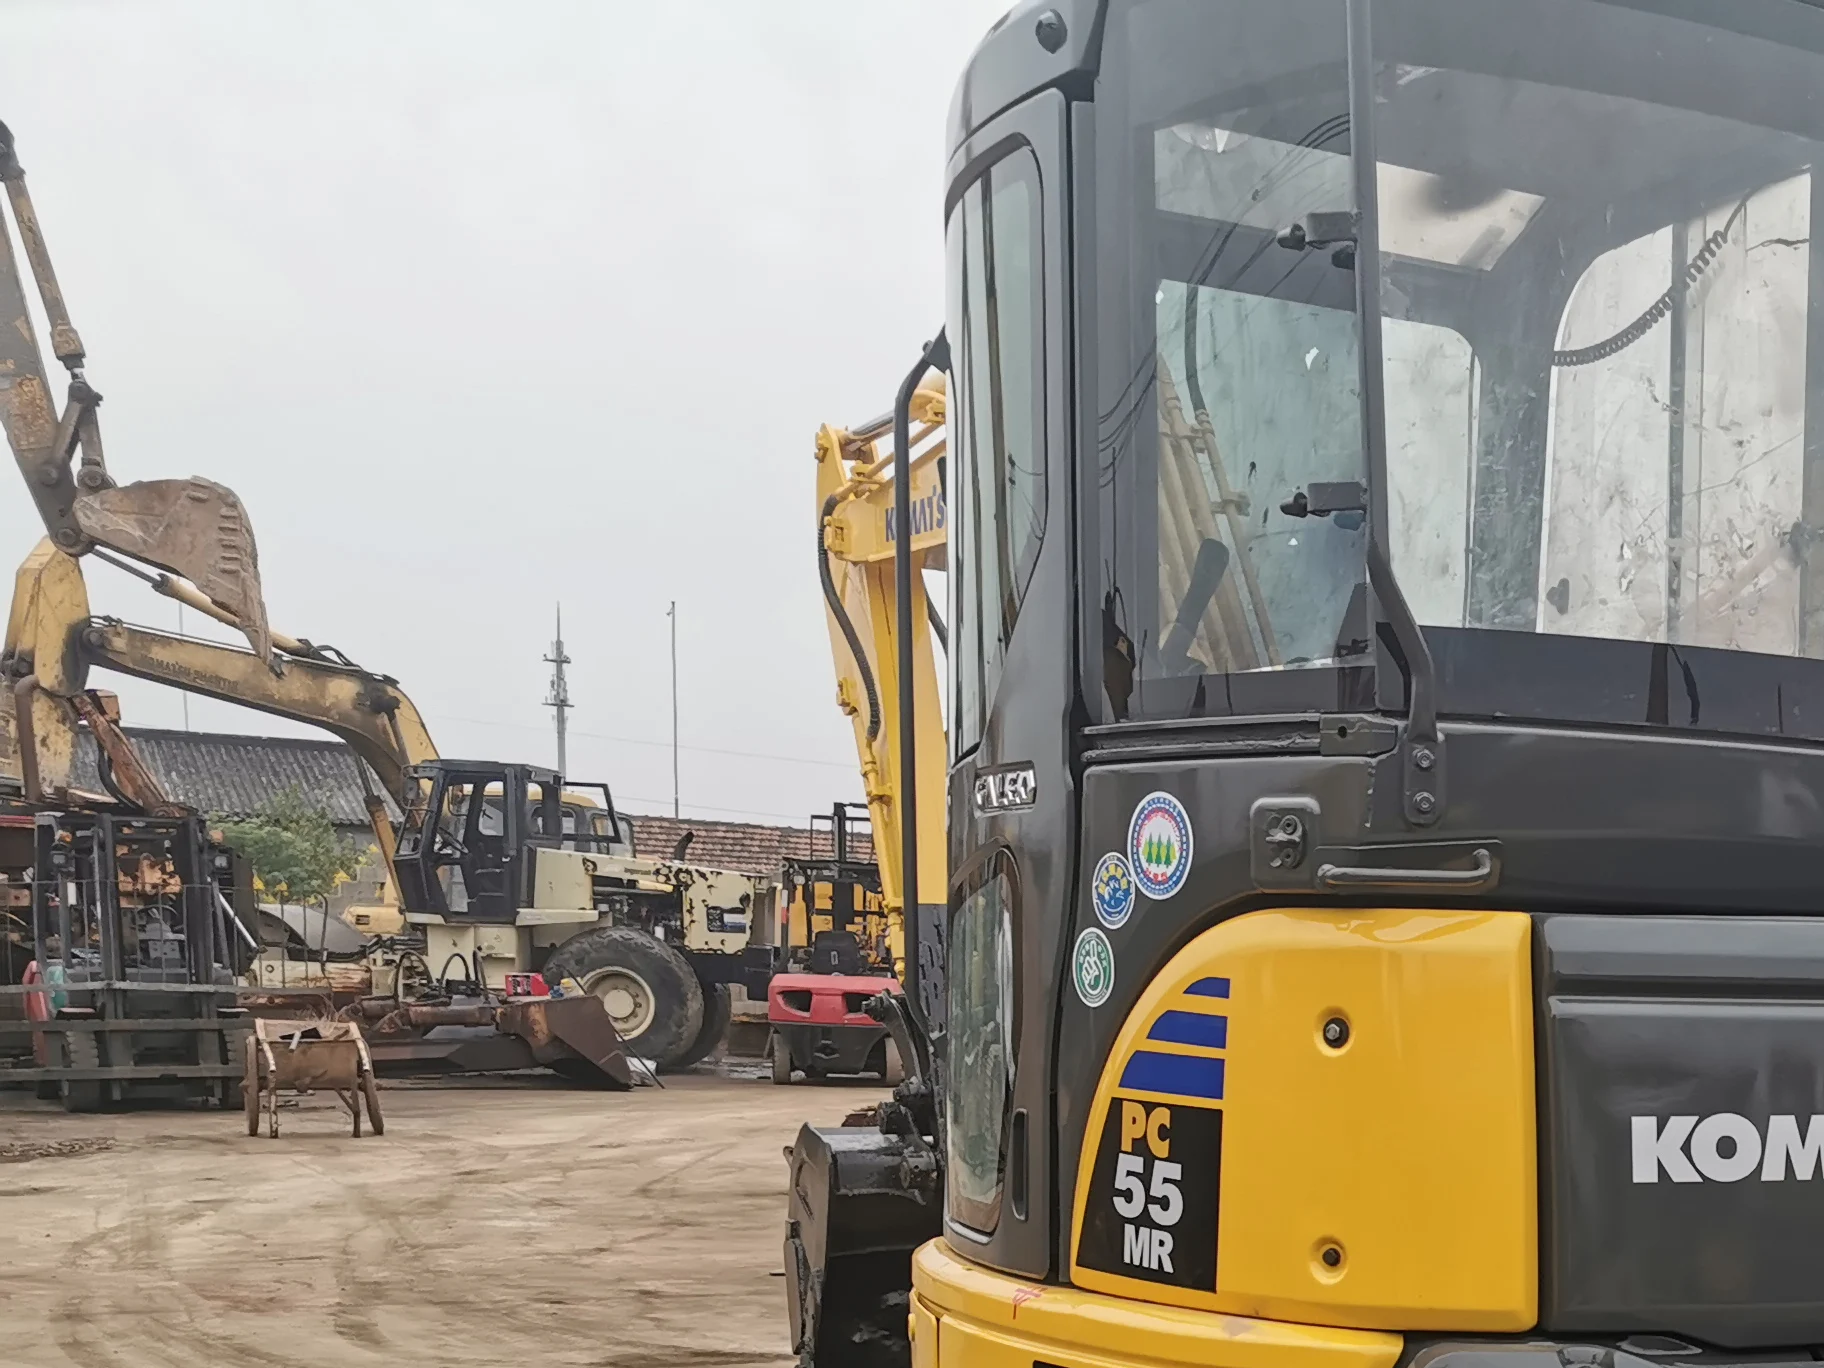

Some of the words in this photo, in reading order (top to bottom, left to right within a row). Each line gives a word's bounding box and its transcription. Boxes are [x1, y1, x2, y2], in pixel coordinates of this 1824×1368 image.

[1120, 1100, 1171, 1159] PC
[1112, 1152, 1184, 1227] 55
[1123, 1223, 1175, 1274] MR
